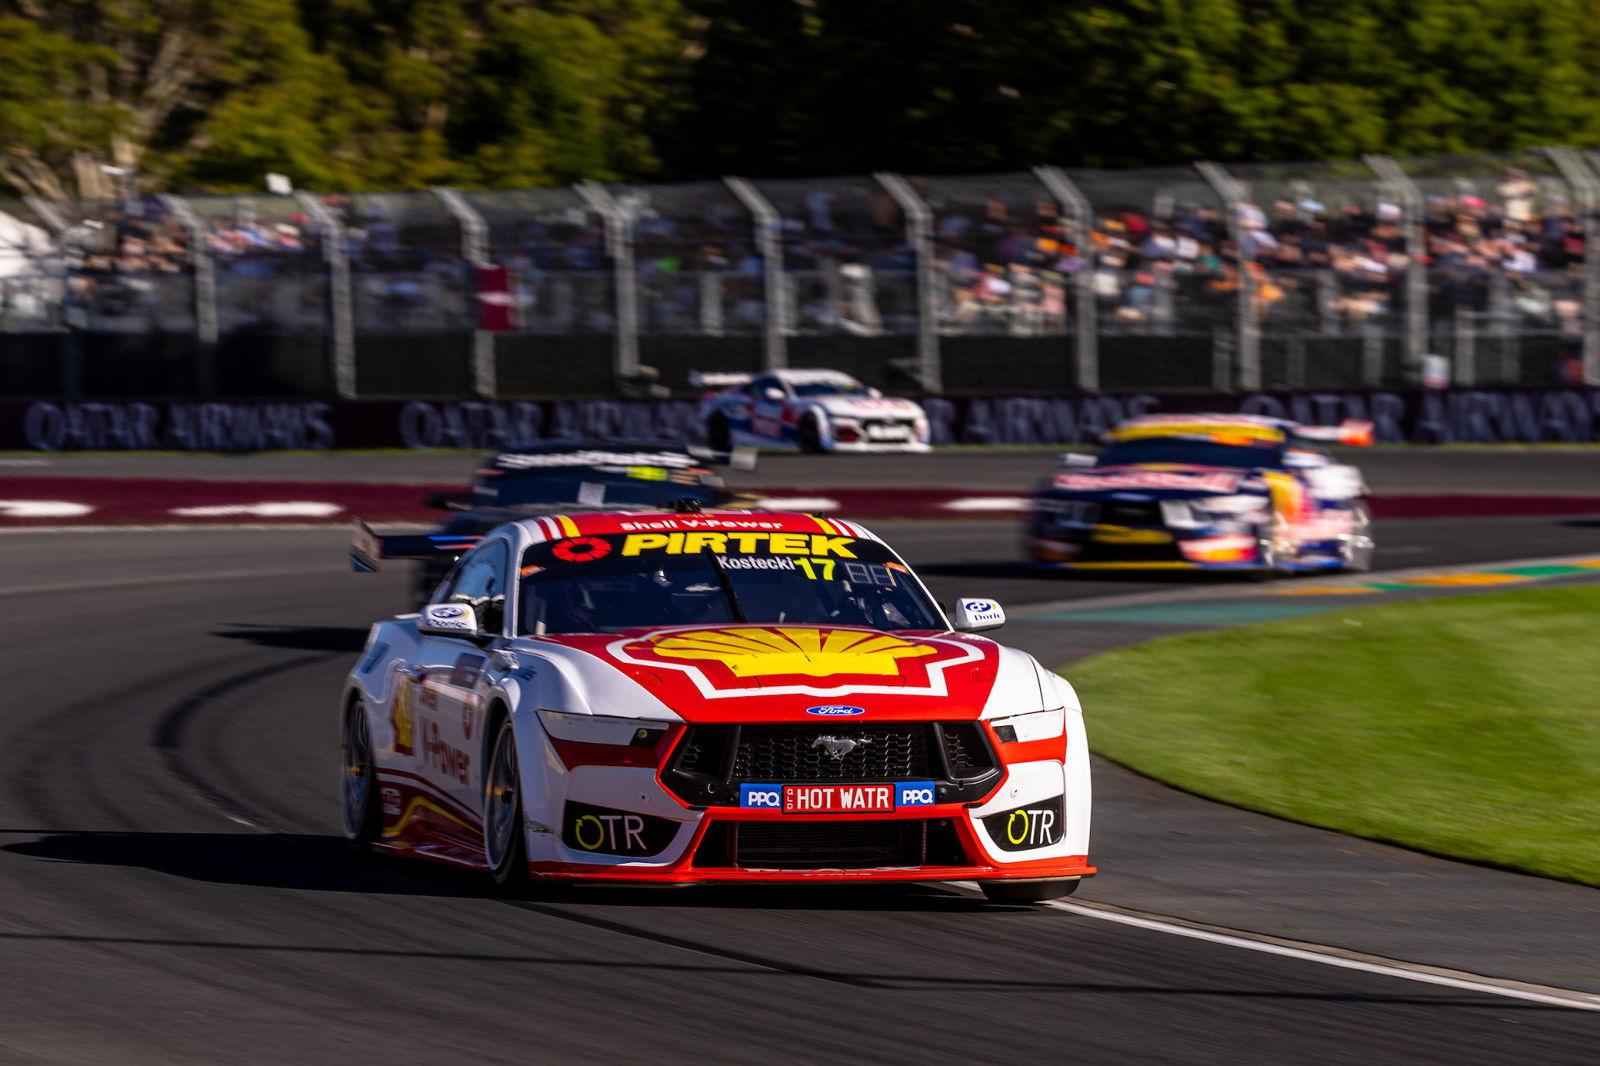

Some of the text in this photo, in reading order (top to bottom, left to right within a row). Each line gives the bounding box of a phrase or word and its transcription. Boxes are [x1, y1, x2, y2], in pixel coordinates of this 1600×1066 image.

[24, 402, 158, 450] QATAR
[620, 518, 783, 531] Shell V-Power
[621, 531, 858, 559] PIRTEK
[717, 555, 796, 570] Kostecki
[793, 557, 836, 581] 17
[817, 706, 854, 715] Ford
[748, 791, 781, 807] PPQ
[796, 788, 835, 809] HOT
[839, 787, 889, 809] WATR
[902, 789, 934, 804] PPQ
[575, 814, 647, 850] OTR
[1007, 809, 1055, 845] OTR
